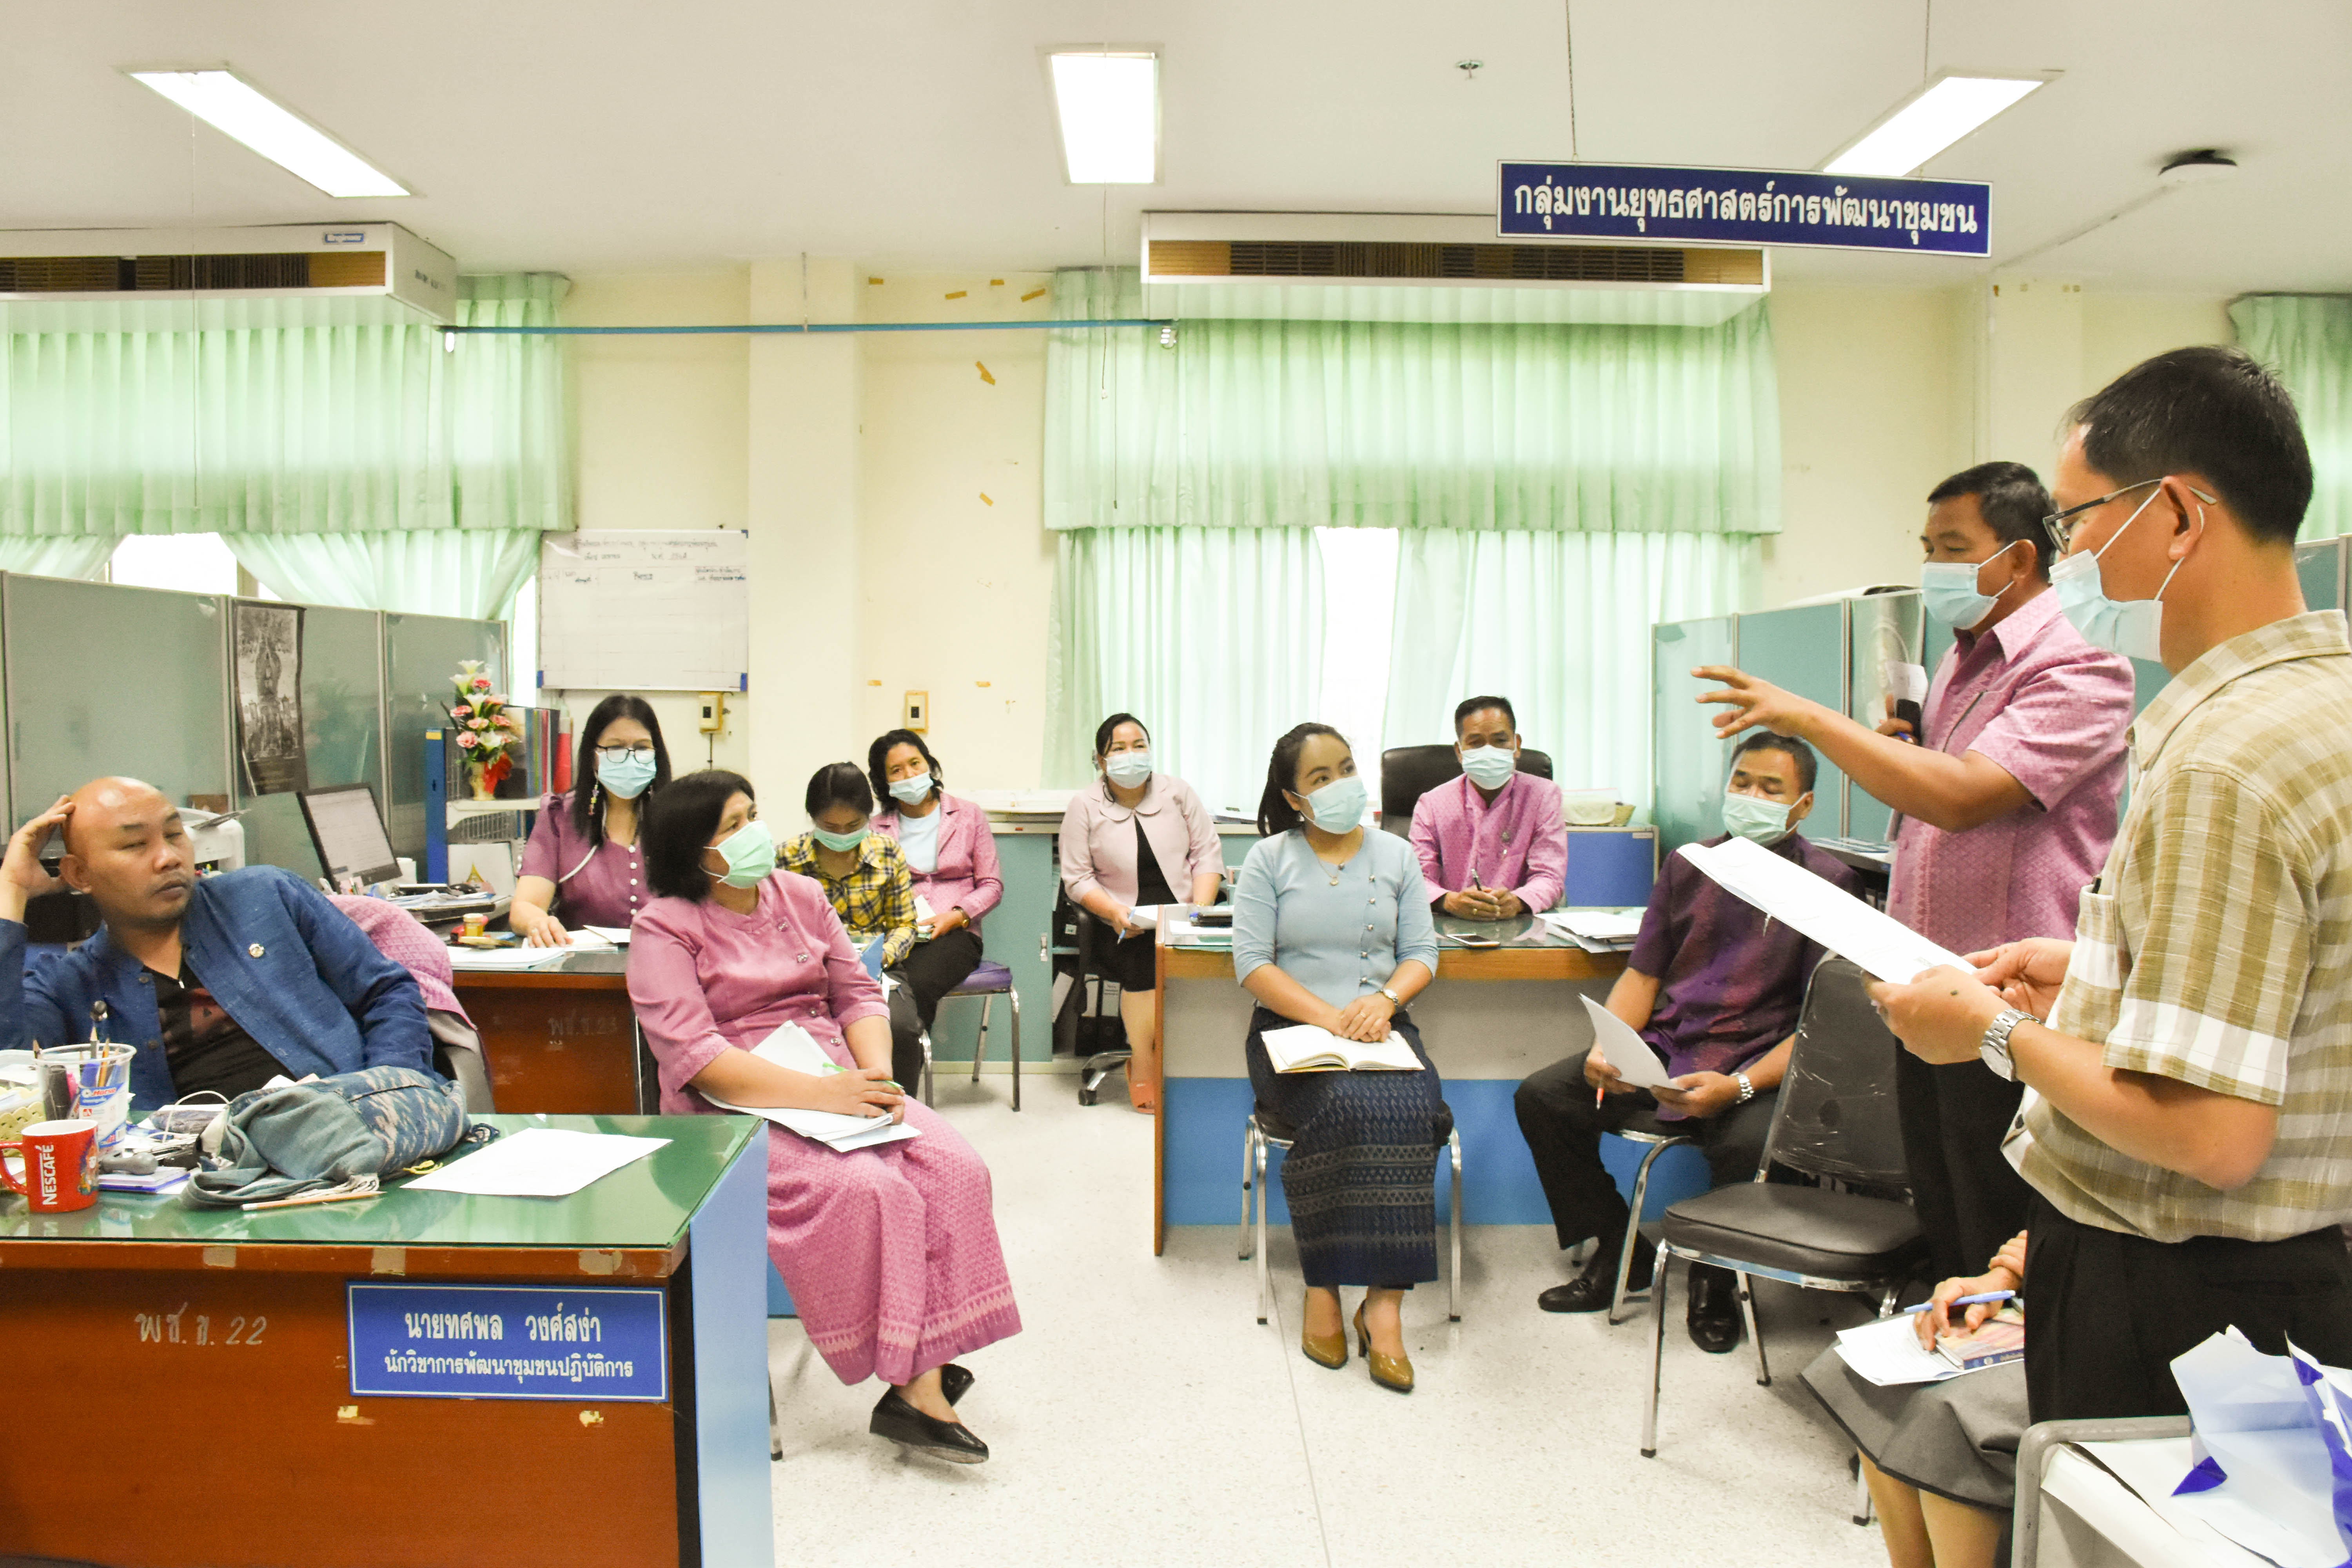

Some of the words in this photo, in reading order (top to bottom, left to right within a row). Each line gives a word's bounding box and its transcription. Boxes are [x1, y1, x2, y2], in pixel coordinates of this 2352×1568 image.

[1514, 174, 1978, 245] กลุ่มงานยุทธศาสตร์การพัฒนาชุมชน
[35, 1145, 58, 1205] NESCAFÉ
[405, 1312, 503, 1340] นายทศพล
[525, 1302, 601, 1342] วงศ์สง่า
[384, 1348, 633, 1384] นักวิชาการพัฒนาชุมชนปฏิบัติการ
